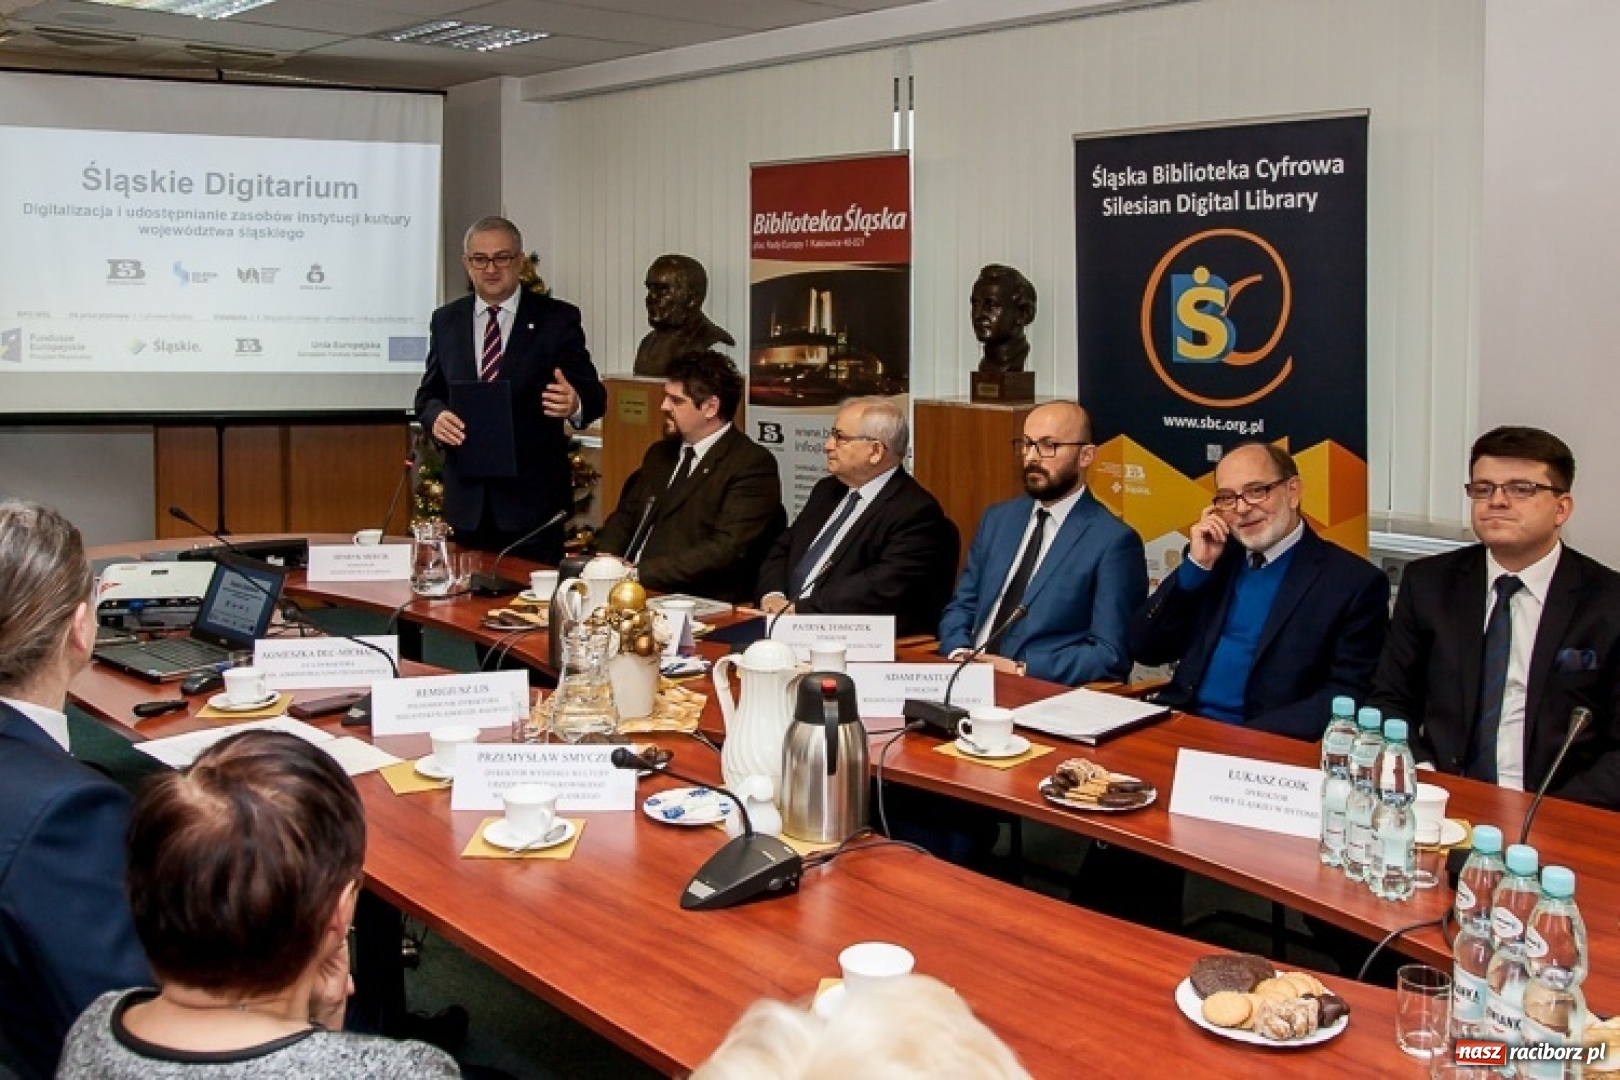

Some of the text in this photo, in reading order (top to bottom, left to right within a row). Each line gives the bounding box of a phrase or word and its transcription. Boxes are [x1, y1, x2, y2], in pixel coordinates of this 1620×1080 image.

[81, 161, 359, 202] Śląskie Digitarium
[1092, 153, 1344, 190] Śląska Biblioteka Cyfrowa
[22, 202, 114, 219] Digitalizacja
[126, 206, 228, 224] udostępnianie
[231, 209, 293, 223] zasobów
[298, 211, 360, 226] instytucji
[364, 212, 411, 228] kultury
[1102, 187, 1319, 217] Silesian Digital Library
[139, 224, 305, 241] województwa śląskiego
[753, 202, 908, 238] Biblioteka Śląska
[1163, 413, 1264, 434] www.sbc.org.pl
[477, 751, 612, 764] PRZEMYSŁAW SMYCZE
[1228, 768, 1276, 787] ŁUKASZ
